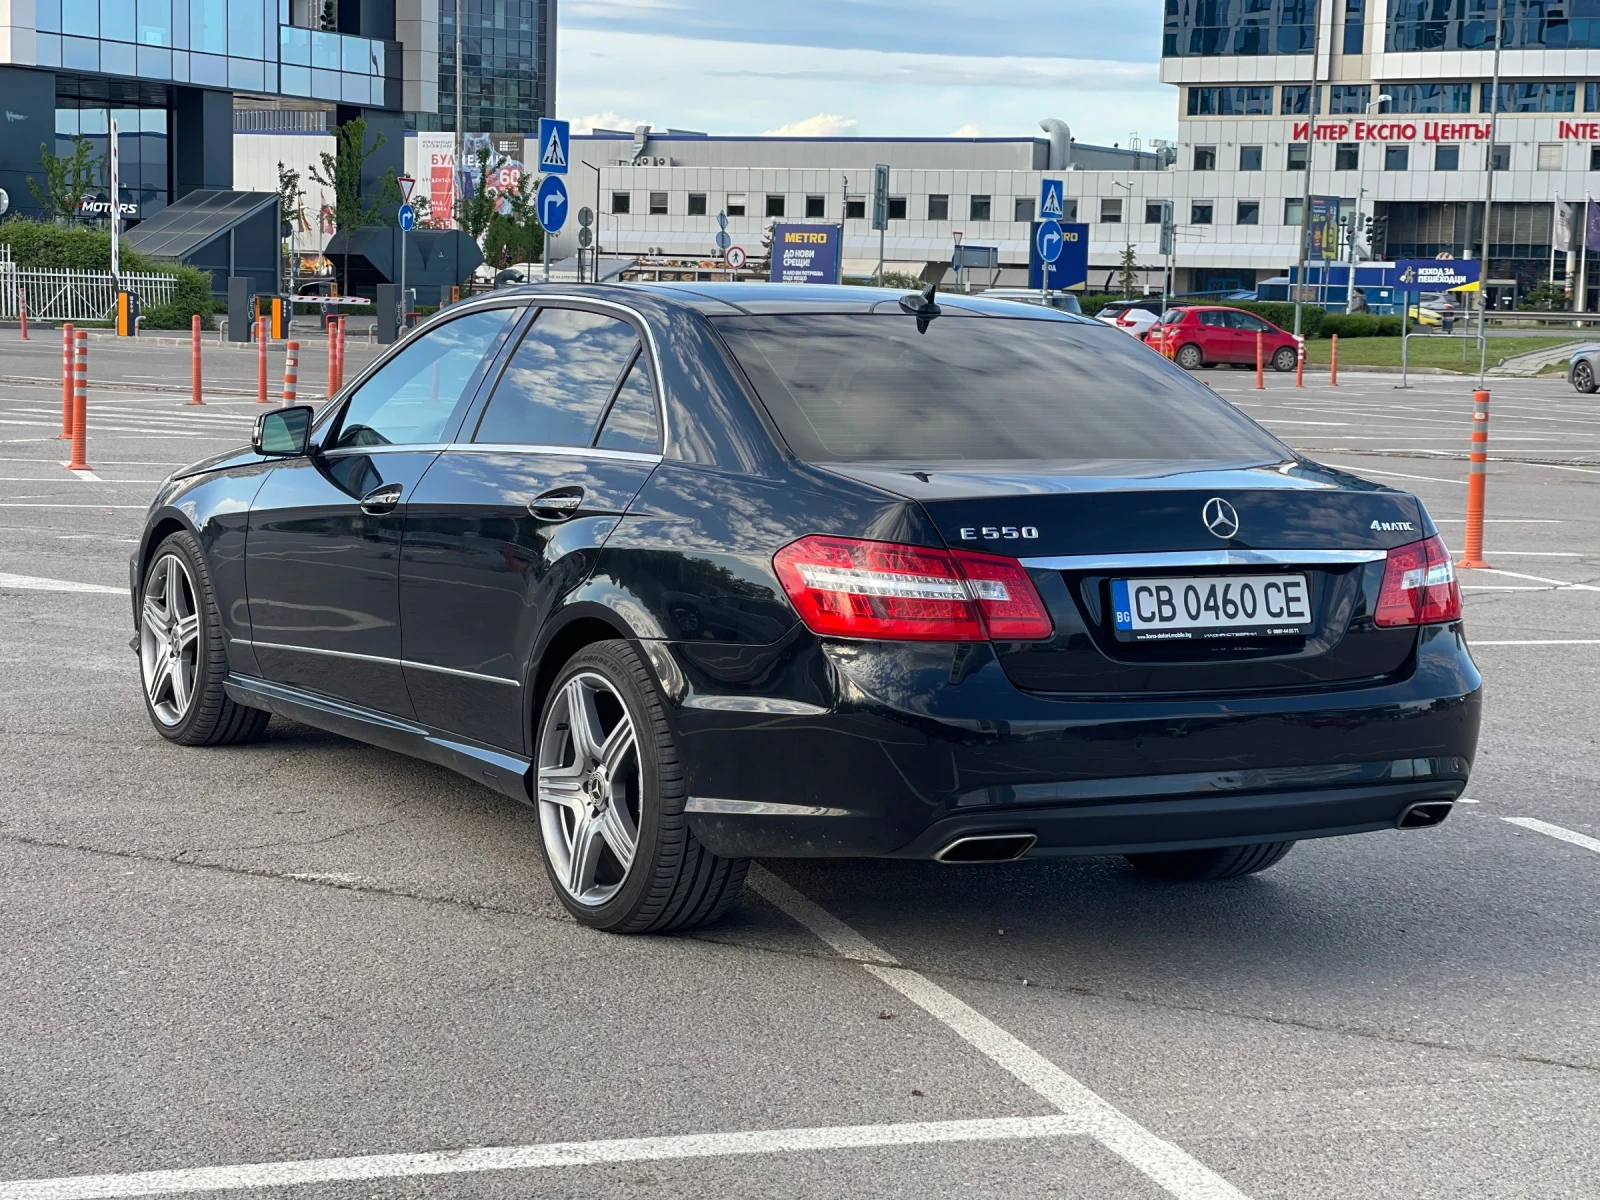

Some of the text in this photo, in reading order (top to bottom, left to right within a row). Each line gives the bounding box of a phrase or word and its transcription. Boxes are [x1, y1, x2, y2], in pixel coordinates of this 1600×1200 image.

[1355, 122, 1416, 140] ЕКСПО
[1558, 121, 1600, 140] INTE
[500, 169, 520, 186] 60
[82, 201, 138, 213] MOTRS
[785, 232, 827, 243] METRO
[783, 249, 815, 258] ДО НОВИ
[783, 258, 811, 267] СРЕЩИ!
[1041, 264, 1057, 272] ВОД
[1418, 268, 1443, 276] ИЗХОД
[1418, 276, 1466, 284] ПЕШЕХОДЦИ
[1370, 520, 1415, 532] 4MATIC
[960, 526, 1039, 540] E 550
[1134, 581, 1305, 623] CB 0460 CE
[1116, 611, 1131, 623] BG
